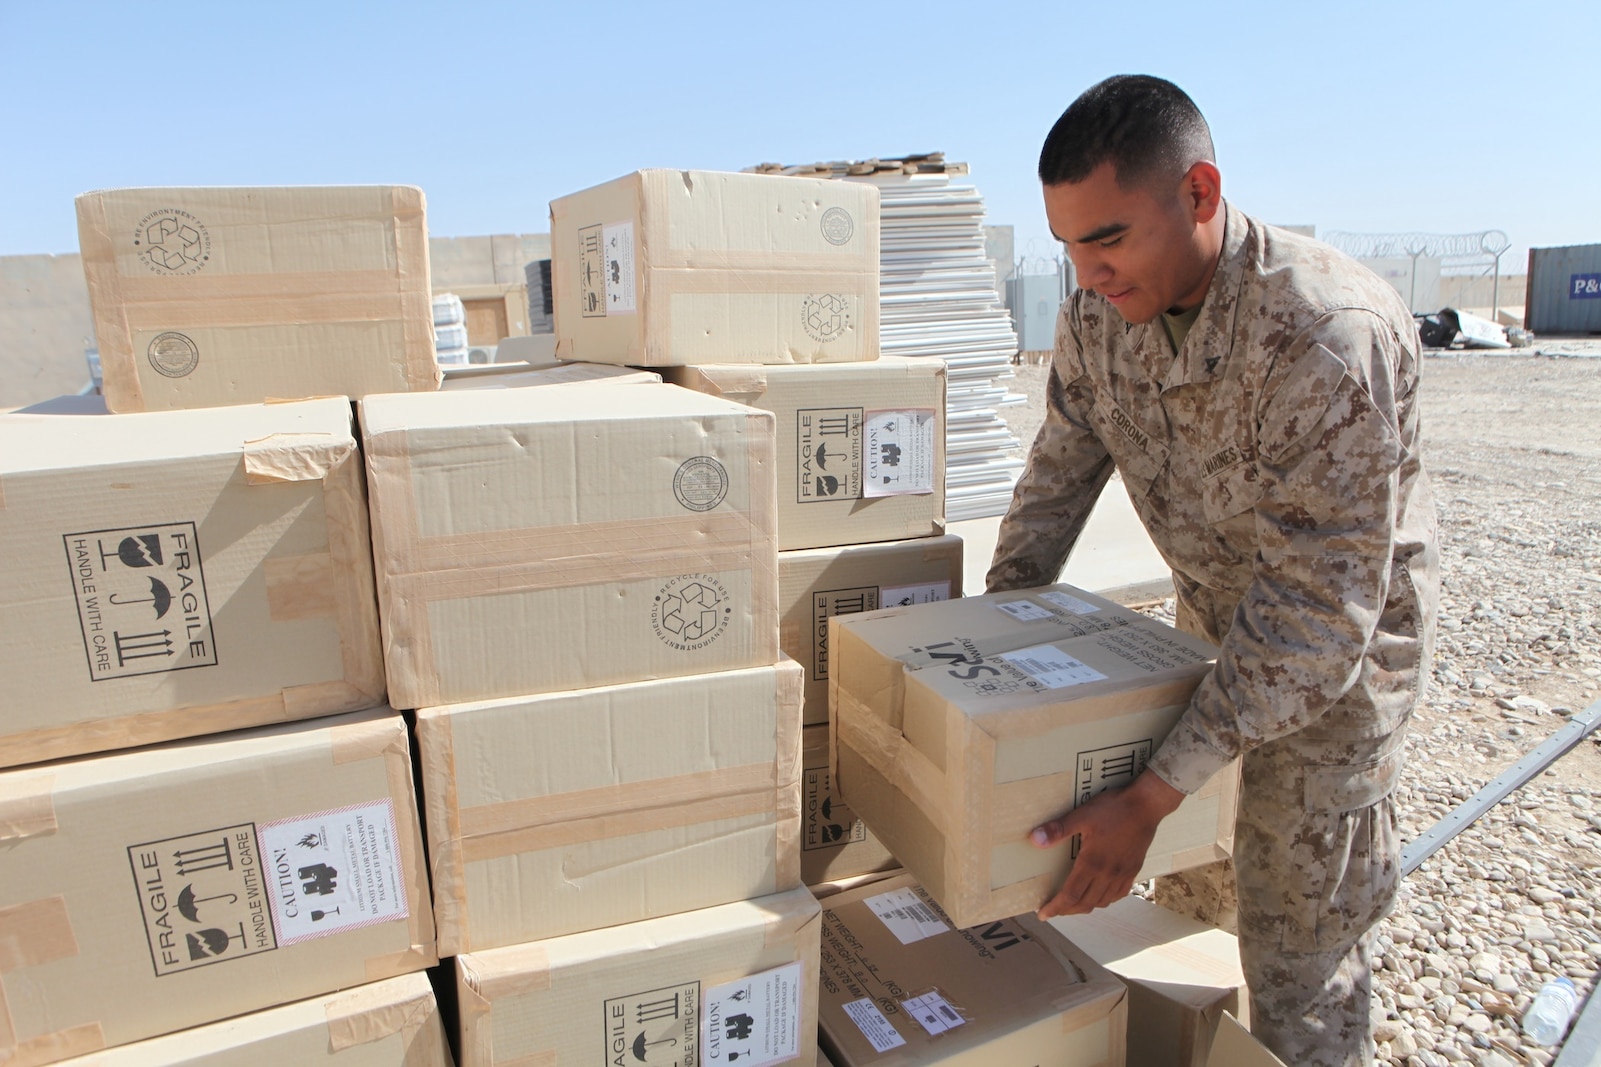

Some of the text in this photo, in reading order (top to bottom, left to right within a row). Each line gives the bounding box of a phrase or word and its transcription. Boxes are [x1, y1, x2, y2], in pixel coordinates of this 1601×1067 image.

[196, 220, 211, 254] FRIENDLY
[1574, 279, 1601, 294] P&
[1110, 408, 1149, 450] CORONA
[802, 416, 812, 496] FRAGILE
[1204, 447, 1237, 475] MARINES
[74, 539, 111, 672] HANDLE WITH CARE
[171, 533, 206, 658] FRAGILE
[660, 573, 730, 602] RECYCLE FOR USE
[652, 603, 730, 650] BE ENVIRONTMENT FRIENDLY
[818, 596, 827, 674] FRAGILE
[1134, 660, 1160, 672] NET
[1137, 650, 1175, 669] GROSS
[808, 774, 818, 844] FRAGILE
[368, 824, 379, 859] DAMAGED
[274, 848, 298, 918] CAUTION!
[357, 815, 378, 914] DO NOT LOAD OR TRANSPORT
[376, 869, 385, 900] PACKAGE
[141, 850, 179, 965] FRAGILE
[236, 832, 268, 948] HANDLE WITH CARE
[823, 909, 840, 924] NET
[835, 921, 864, 952] WEIGHT:
[880, 980, 904, 998] (KG)
[828, 936, 857, 968] WEIGHT:
[876, 996, 899, 1016] (KG)
[836, 968, 853, 984] 378
[848, 982, 864, 998] MM
[685, 988, 694, 1016] CARE
[774, 1008, 779, 1016] OR
[685, 1018, 694, 1043] WITH
[710, 1002, 720, 1058] CAUTION!
[774, 1047, 778, 1055] DO
